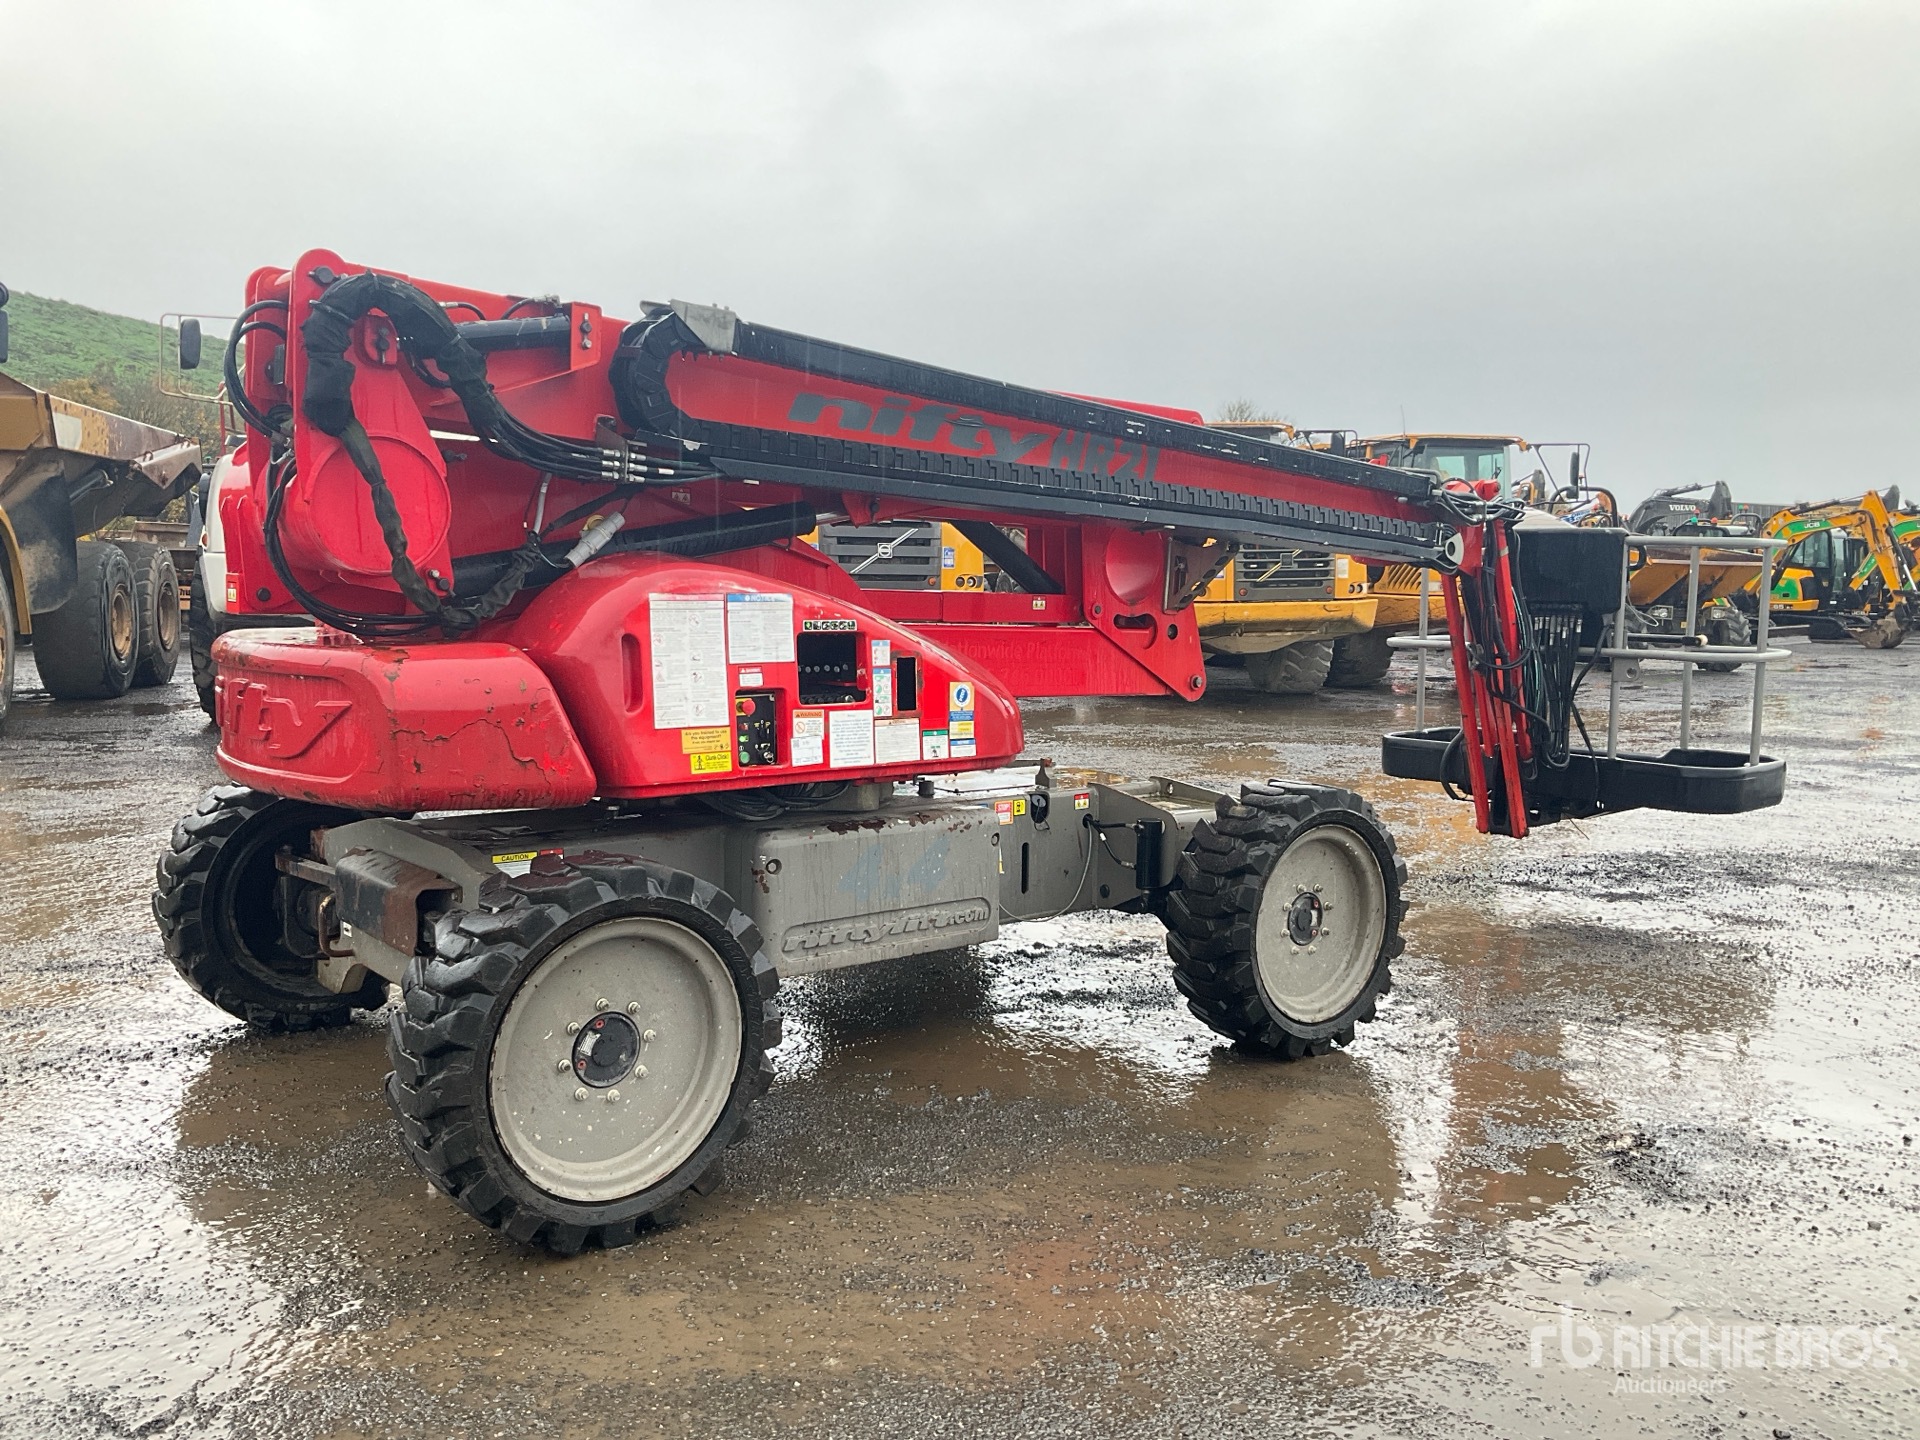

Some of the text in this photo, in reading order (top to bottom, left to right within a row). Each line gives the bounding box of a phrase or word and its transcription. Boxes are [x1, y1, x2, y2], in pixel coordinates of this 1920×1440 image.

[788, 392, 1056, 464] nifty
[1803, 521, 1821, 529] JCB
[501, 854, 529, 862] CAUTION
[783, 906, 989, 952] niftylift.com
